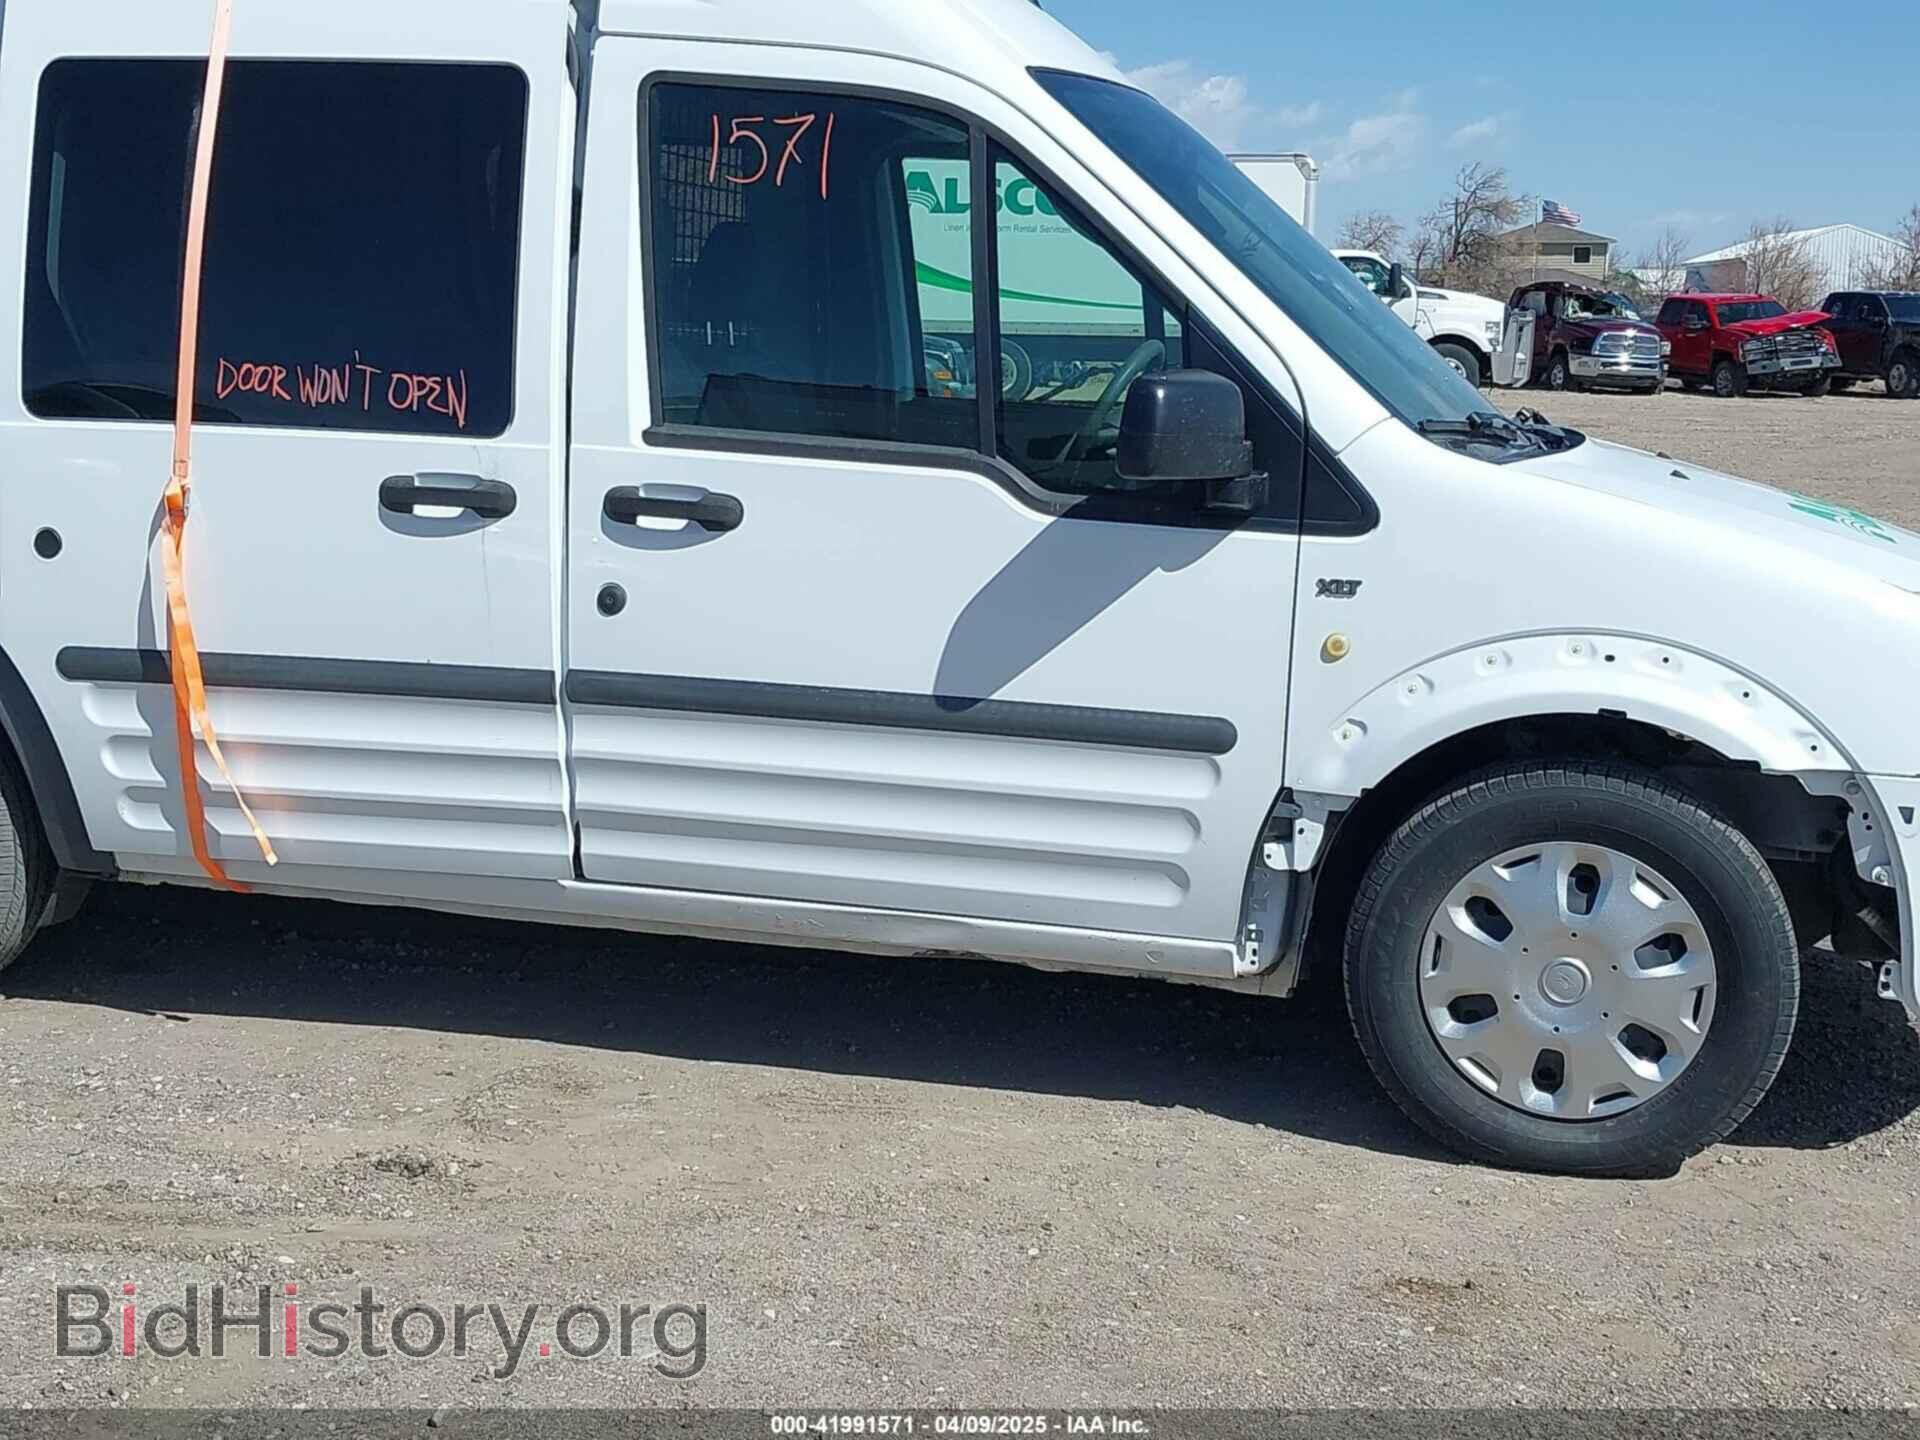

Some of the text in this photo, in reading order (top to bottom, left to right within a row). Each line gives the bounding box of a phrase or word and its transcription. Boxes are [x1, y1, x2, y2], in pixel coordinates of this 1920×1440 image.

[709, 112, 834, 200] 1571
[1013, 223, 1037, 233] Rental
[216, 350, 467, 429] DOOR WON'T OPEN
[1315, 578, 1362, 599] XLT
